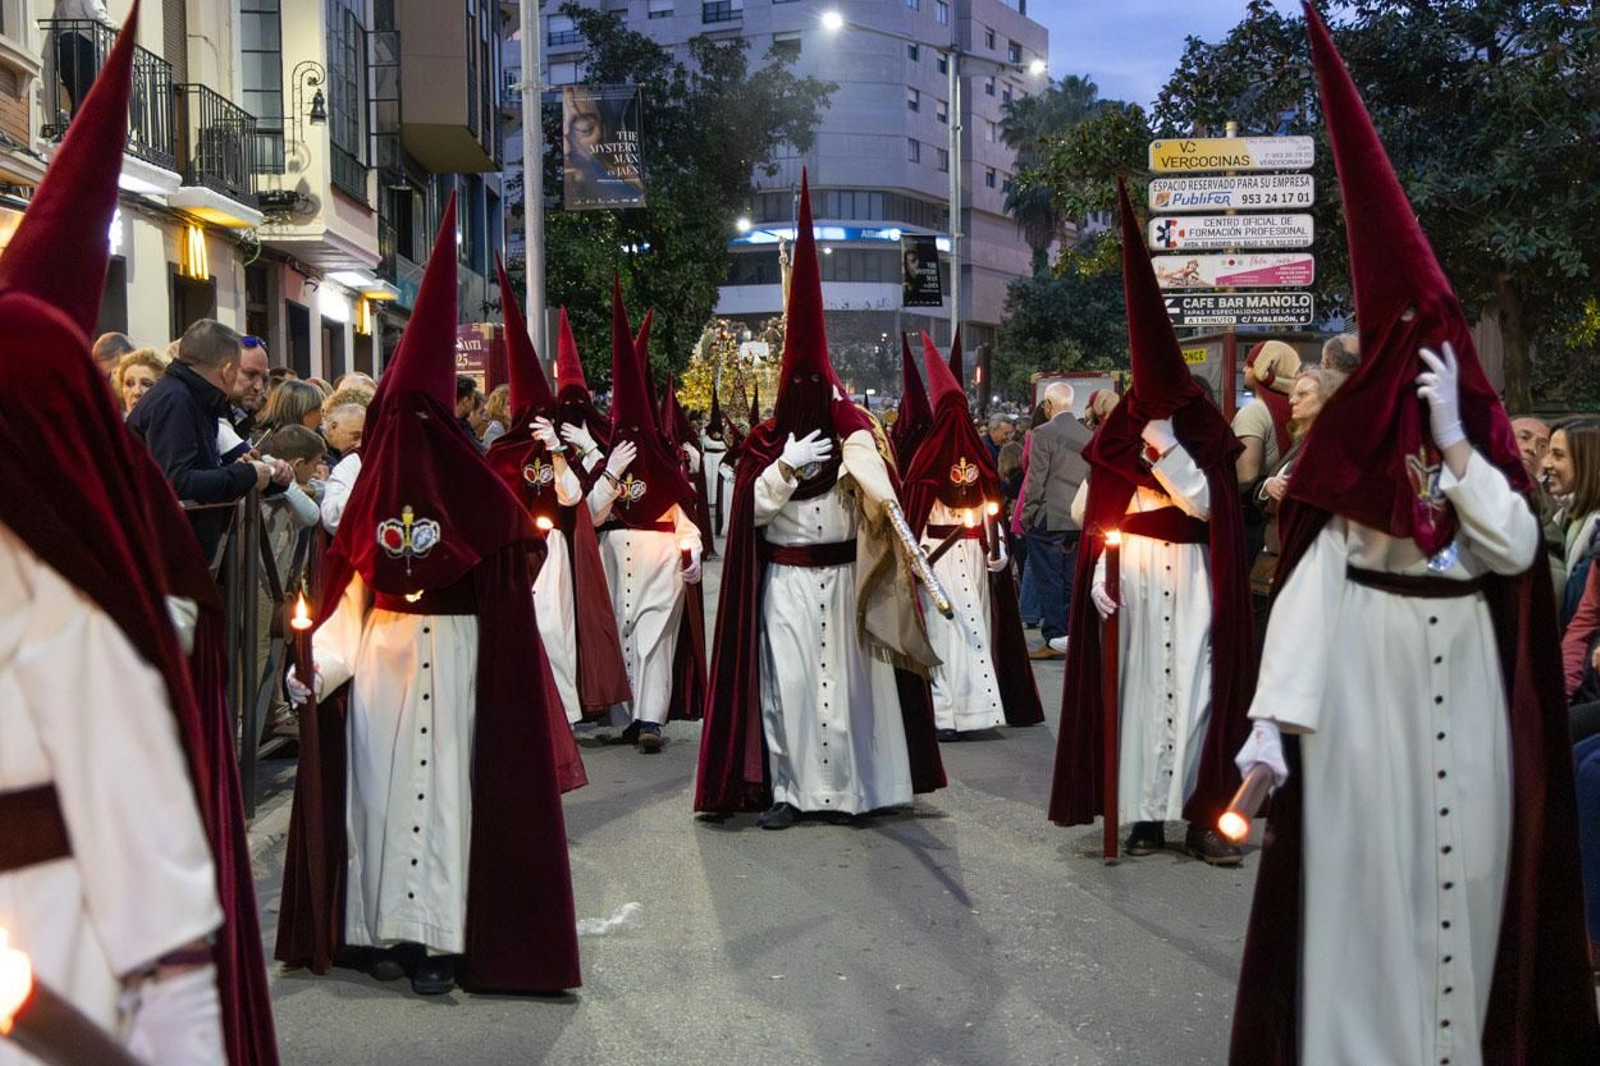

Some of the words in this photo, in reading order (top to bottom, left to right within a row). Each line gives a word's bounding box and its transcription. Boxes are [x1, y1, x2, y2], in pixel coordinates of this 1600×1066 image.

[616, 131, 638, 141] THE
[590, 142, 638, 154] MYSTERY
[614, 153, 638, 164] MAN
[1161, 155, 1250, 169] VERCOCINAS
[1153, 180, 1186, 192] ESPACIO
[1188, 179, 1235, 190] RESERVADO
[1237, 178, 1258, 188] PARA
[1260, 178, 1270, 188] SU
[1272, 176, 1310, 187] EMPRESA
[1242, 194, 1261, 204] 953
[1265, 194, 1277, 203] 24
[1282, 193, 1294, 203] 17
[1297, 193, 1310, 202] 01
[1204, 218, 1239, 227] CENTRO
[1243, 217, 1278, 226] OFICIAL
[1281, 217, 1292, 225] DE
[1190, 227, 1242, 237] FORMACIÓN
[1245, 226, 1308, 235] PROFESIONAL
[1183, 298, 1214, 308] CAFE
[1218, 298, 1243, 308] BAR
[1246, 296, 1310, 307] MANOLO
